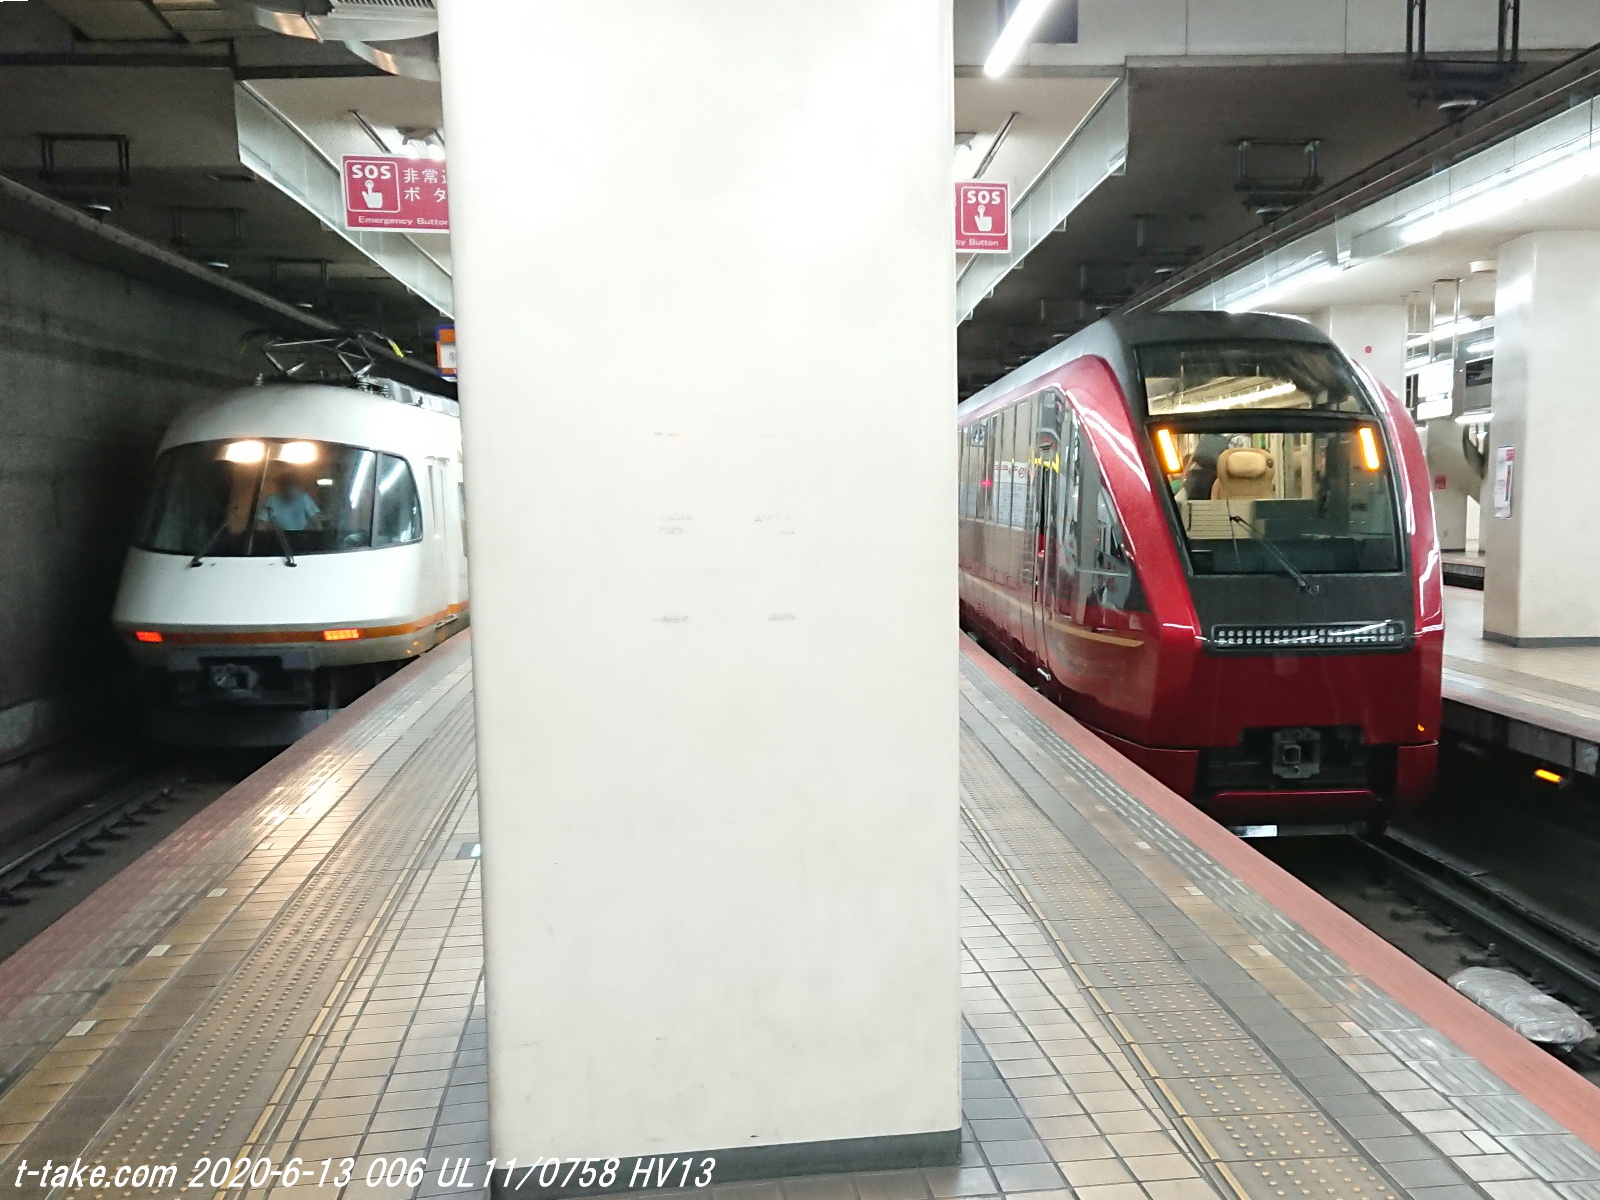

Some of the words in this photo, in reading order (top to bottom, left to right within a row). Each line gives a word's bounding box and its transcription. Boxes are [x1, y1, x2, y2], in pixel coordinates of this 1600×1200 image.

[351, 164, 392, 180] SOS
[966, 190, 1001, 205] SOS
[357, 215, 413, 226] Emergency
[968, 238, 999, 246] Button
